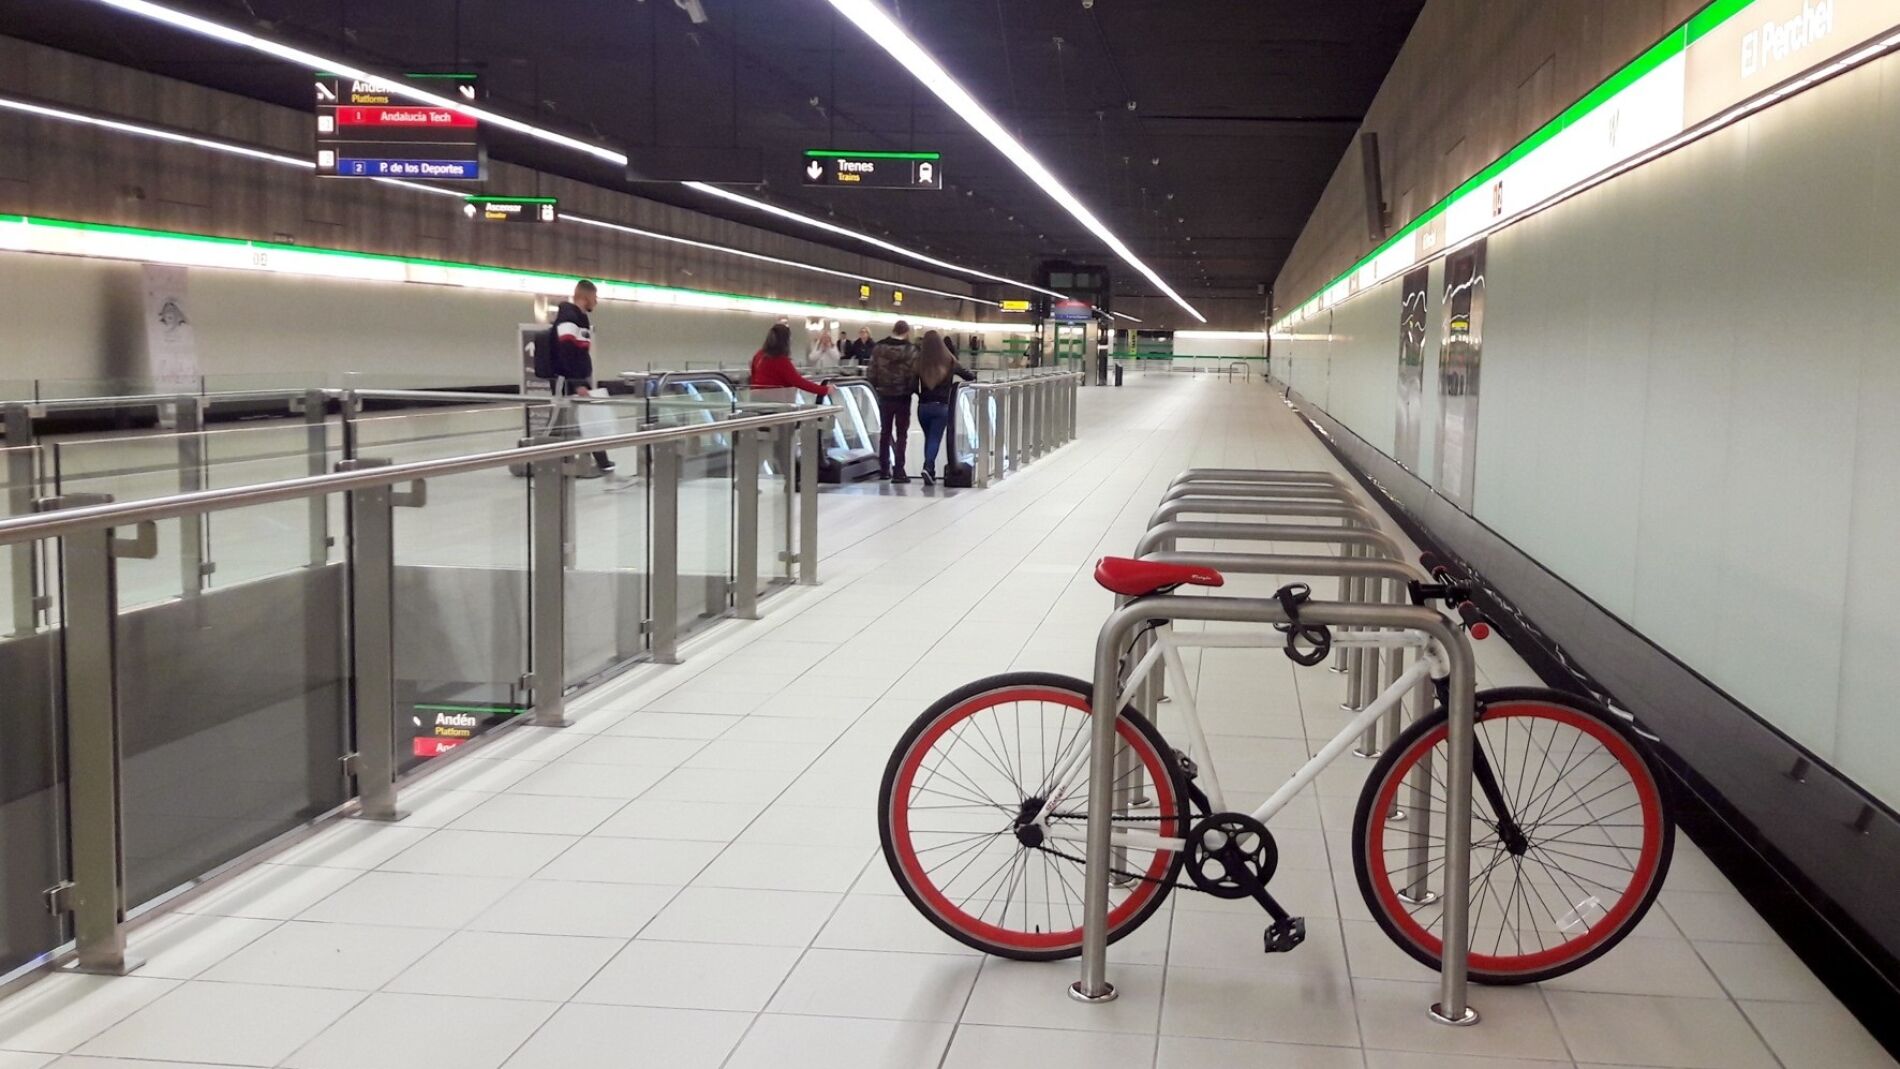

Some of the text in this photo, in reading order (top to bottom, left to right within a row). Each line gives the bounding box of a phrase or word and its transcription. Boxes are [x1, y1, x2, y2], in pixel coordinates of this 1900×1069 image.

[352, 93, 389, 104] Platforms
[430, 112, 451, 123] Tech
[379, 162, 464, 176] P. de los Deportes
[837, 159, 874, 172] Trenes
[837, 173, 861, 182] Trains
[435, 712, 476, 726] Andén
[435, 726, 470, 736] Platform
